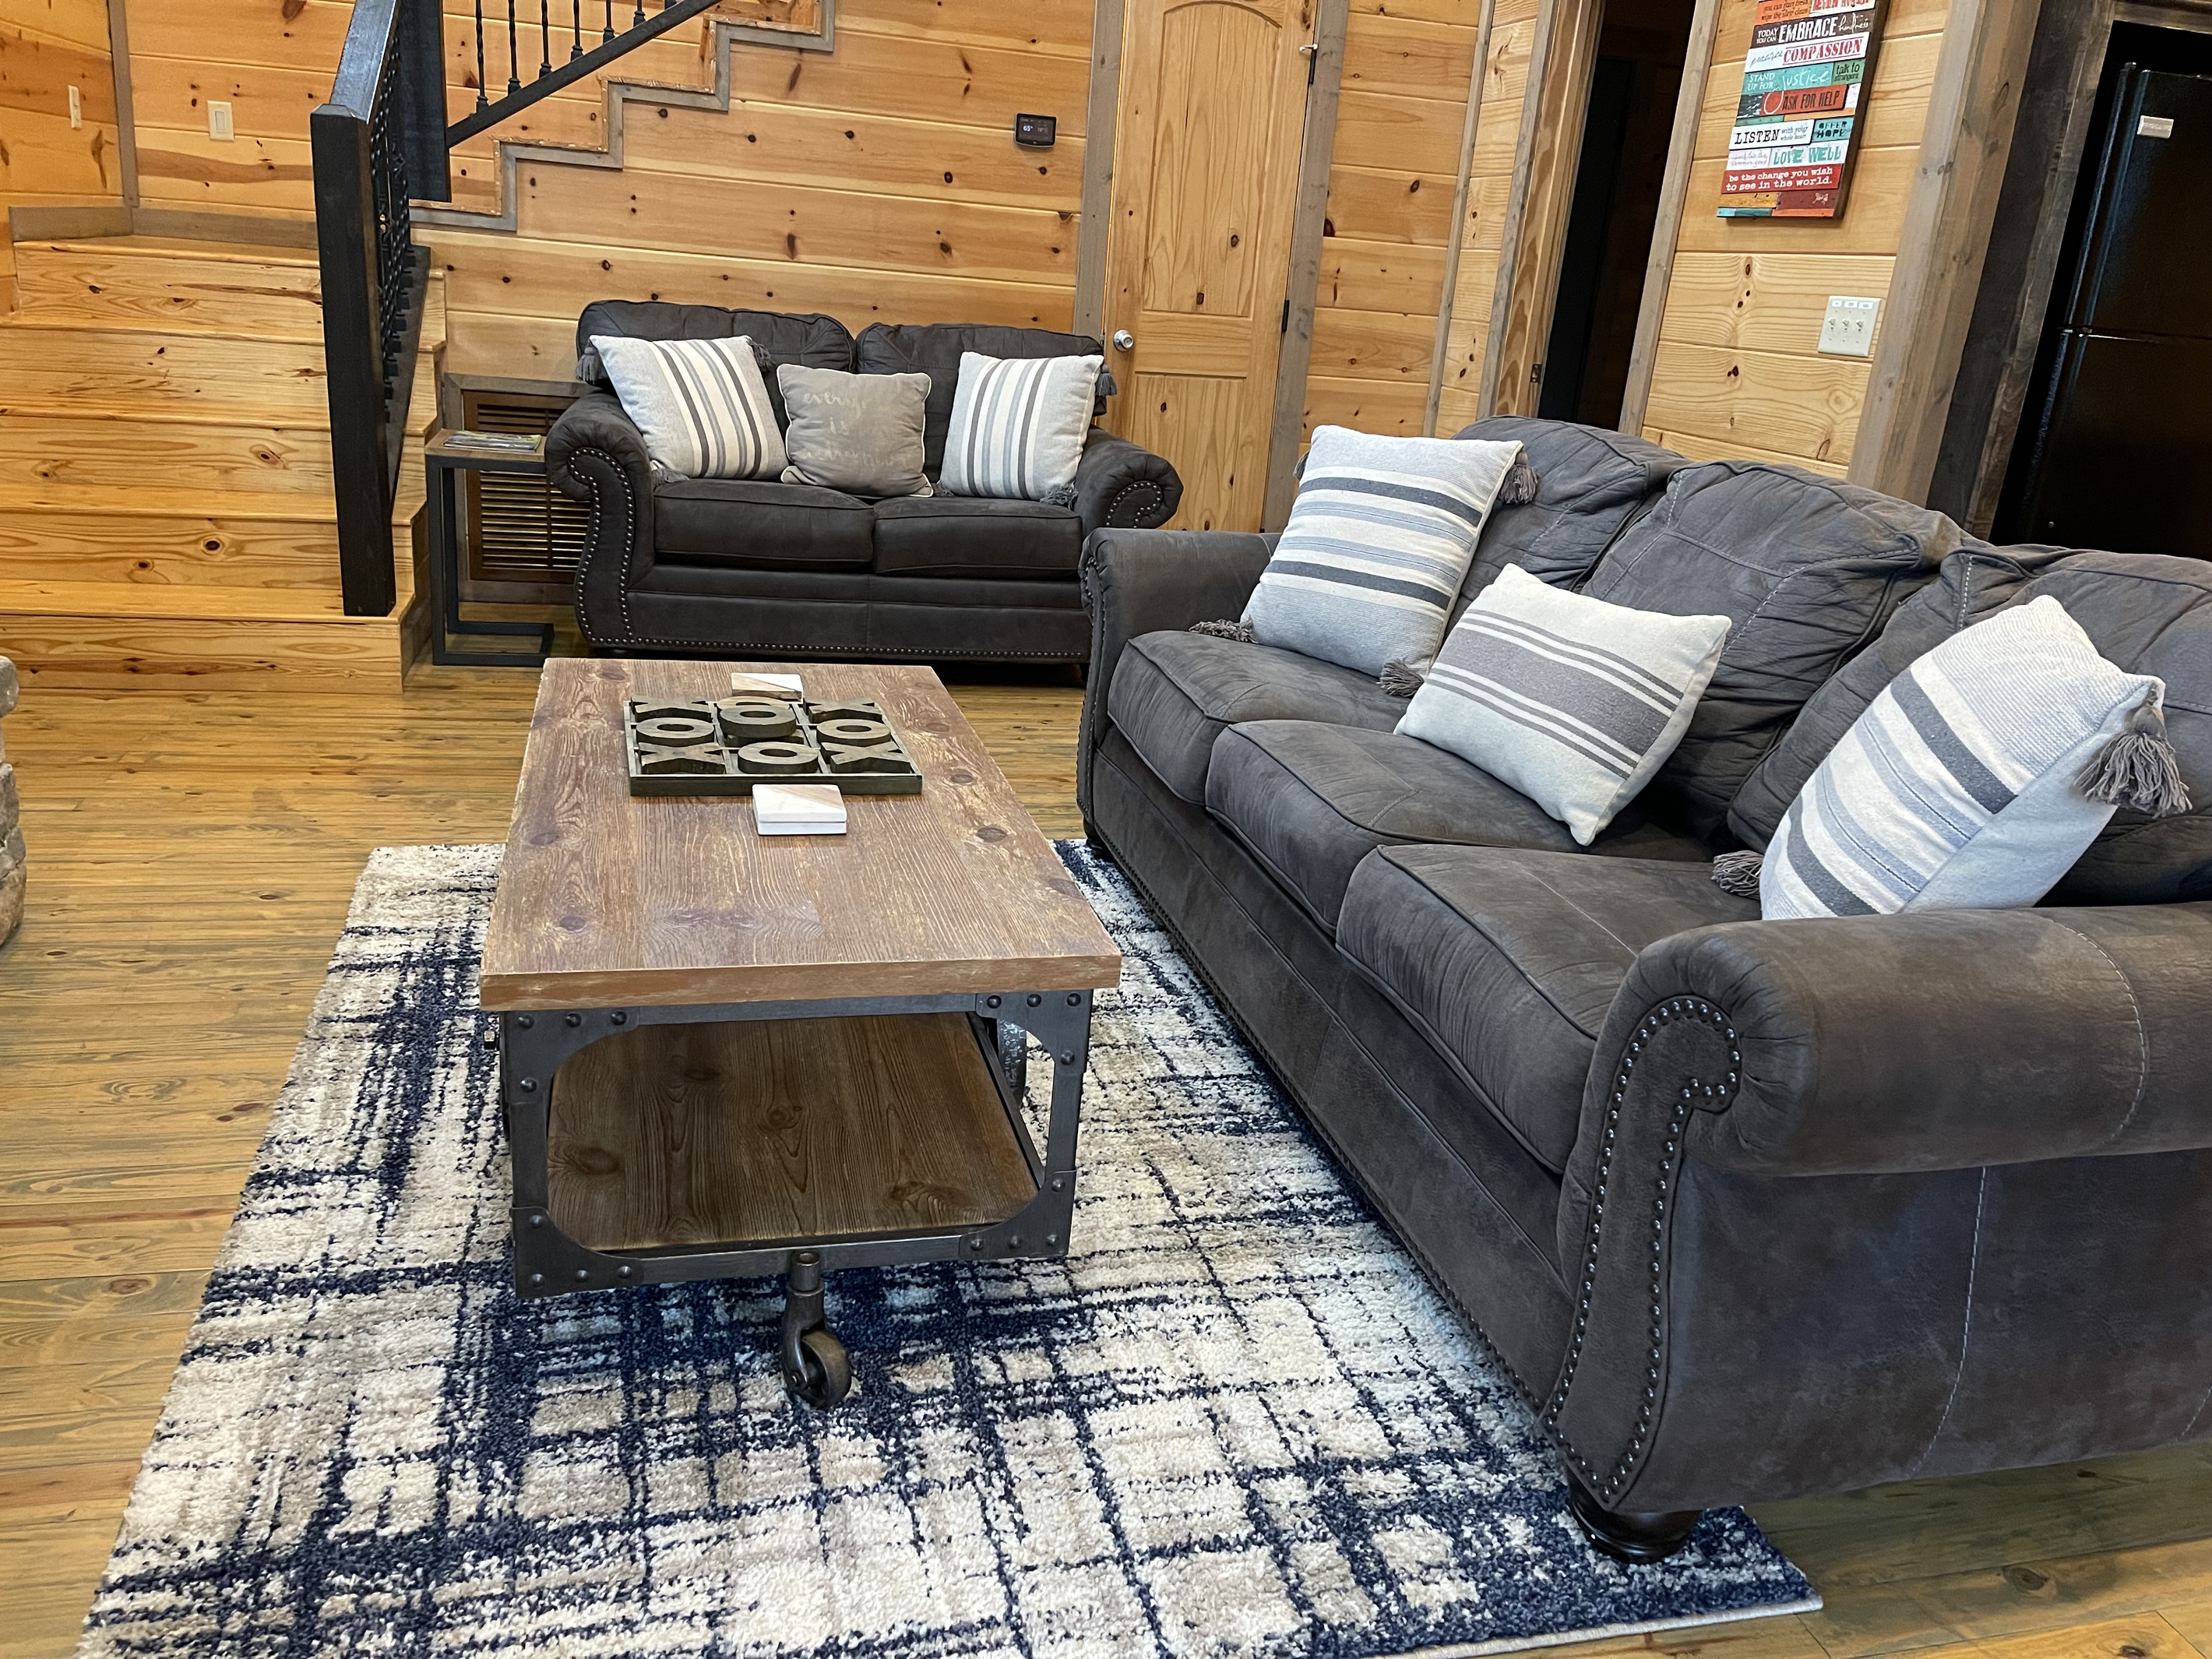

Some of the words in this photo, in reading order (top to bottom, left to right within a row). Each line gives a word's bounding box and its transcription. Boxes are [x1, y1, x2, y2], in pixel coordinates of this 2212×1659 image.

[1758, 27, 1778, 37] TODAY
[1778, 16, 1838, 43] EMBRACE
[1784, 39, 1862, 62] COMPASSION
[1836, 64, 1850, 74] talk
[1851, 62, 1860, 72] to
[1749, 72, 1775, 83] STAND
[1759, 81, 1773, 90] FOR
[1782, 95, 1798, 111] ASK
[1801, 93, 1816, 109] FOR
[1819, 90, 1840, 107] HELP
[1735, 129, 1781, 145] LISTEN
[1816, 129, 1844, 138] HOPE
[1773, 148, 1804, 165] LOVE
[1809, 146, 1841, 164] WELL
[1757, 171, 1789, 180] change
[1791, 170, 1809, 178] you
[1811, 167, 1833, 175] wish
[1758, 181, 1770, 189] in
[1773, 179, 1793, 188] the
[1796, 176, 1833, 186] world.
